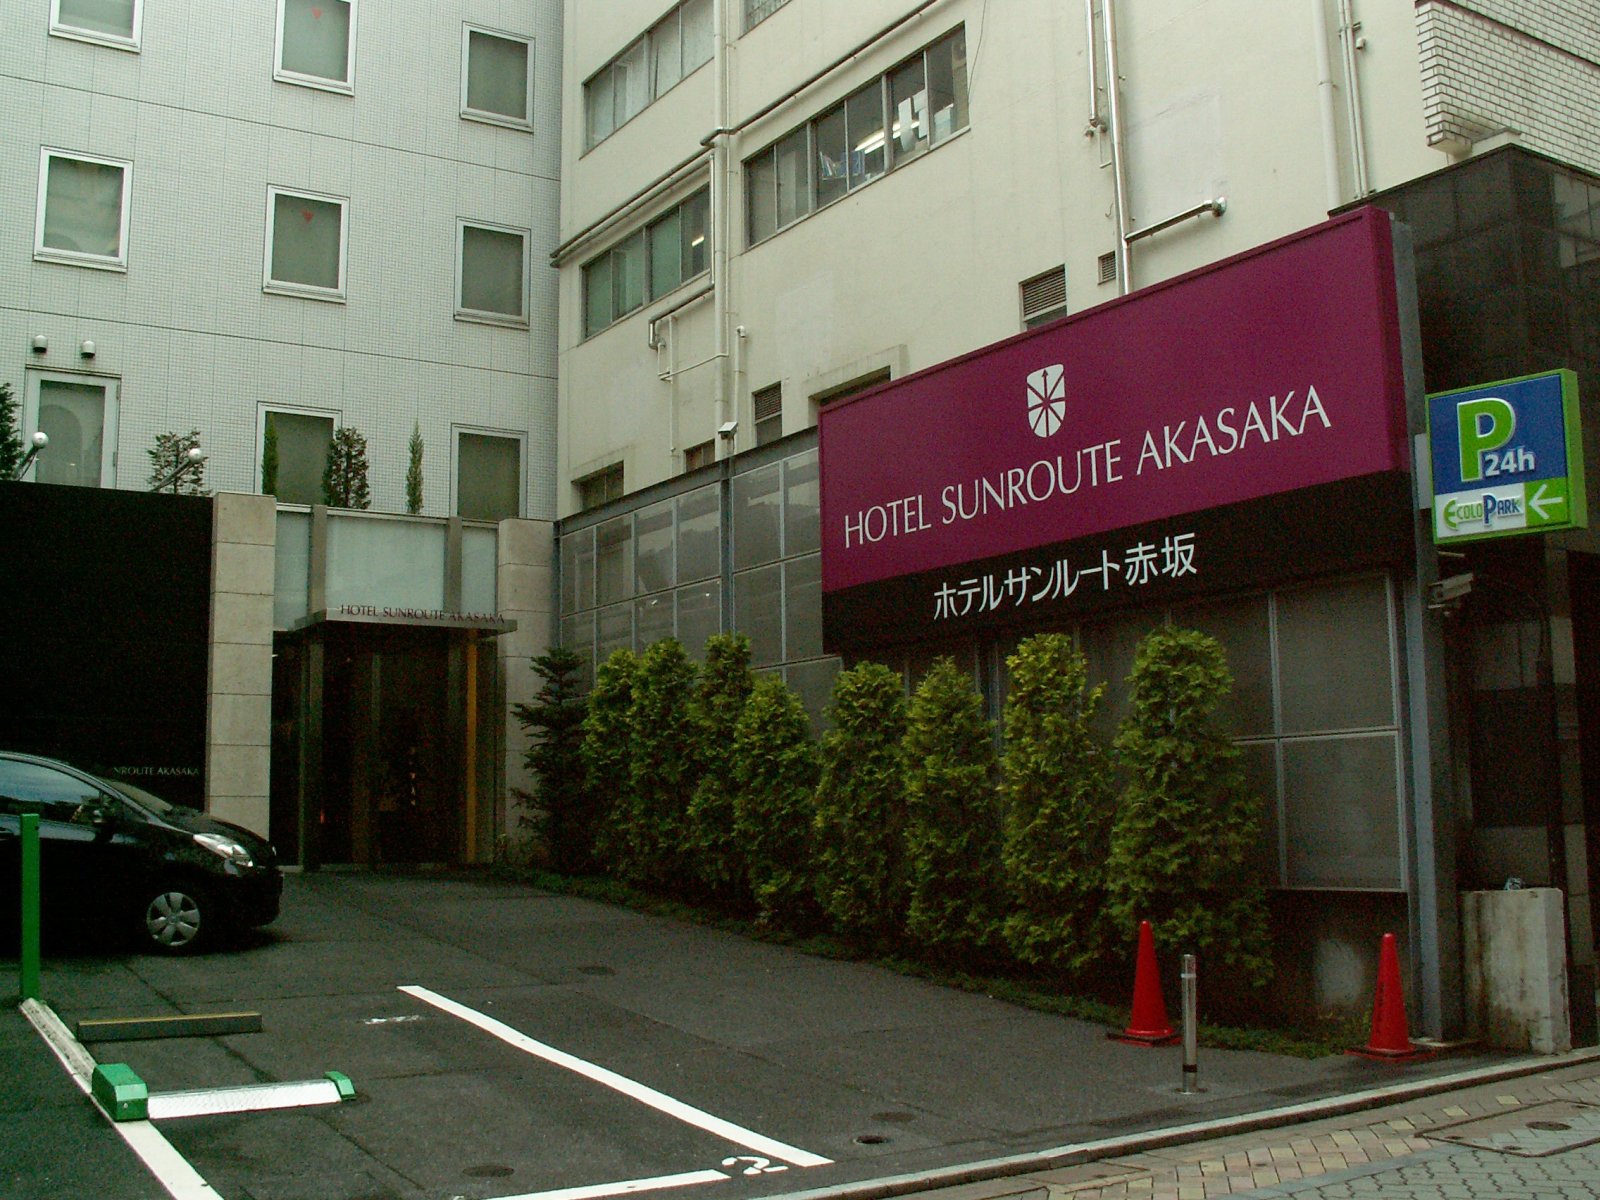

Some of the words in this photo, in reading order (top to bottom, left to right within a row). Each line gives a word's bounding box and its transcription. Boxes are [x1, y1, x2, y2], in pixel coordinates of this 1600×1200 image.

[1456, 397, 1517, 483] P
[844, 494, 932, 549] HOTEL
[941, 440, 1124, 524] SUNROUTE
[1136, 384, 1332, 475] AKASAKA
[1484, 446, 1536, 477] 24h
[933, 532, 1198, 621] ホテルサンルート赤坂
[340, 604, 378, 617] HOTEL
[382, 606, 445, 621] SUNROUTE
[449, 610, 505, 624] AKASAKA
[156, 766, 200, 776] AKASAKA
[721, 1155, 789, 1176] 2
